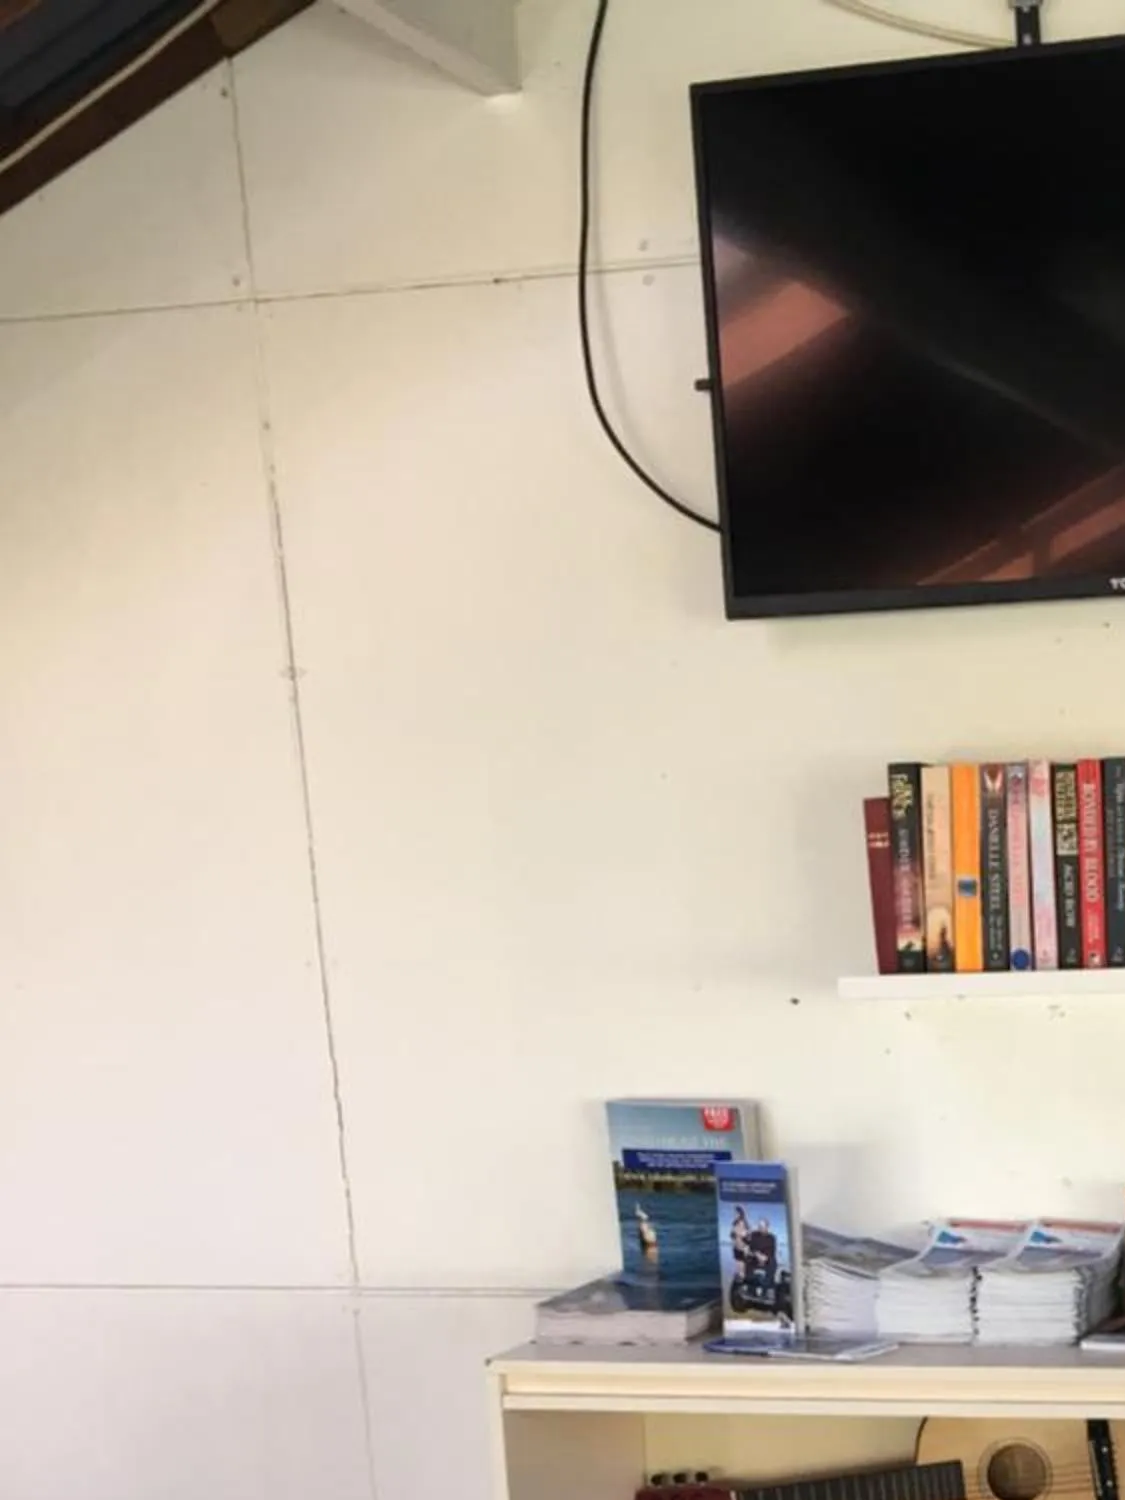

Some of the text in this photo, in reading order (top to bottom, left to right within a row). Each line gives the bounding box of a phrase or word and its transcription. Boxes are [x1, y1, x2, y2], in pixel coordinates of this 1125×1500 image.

[988, 809, 1001, 869] DANIELLE
[990, 873, 1002, 911] STEEL
[1085, 857, 1100, 902] BLOOD
